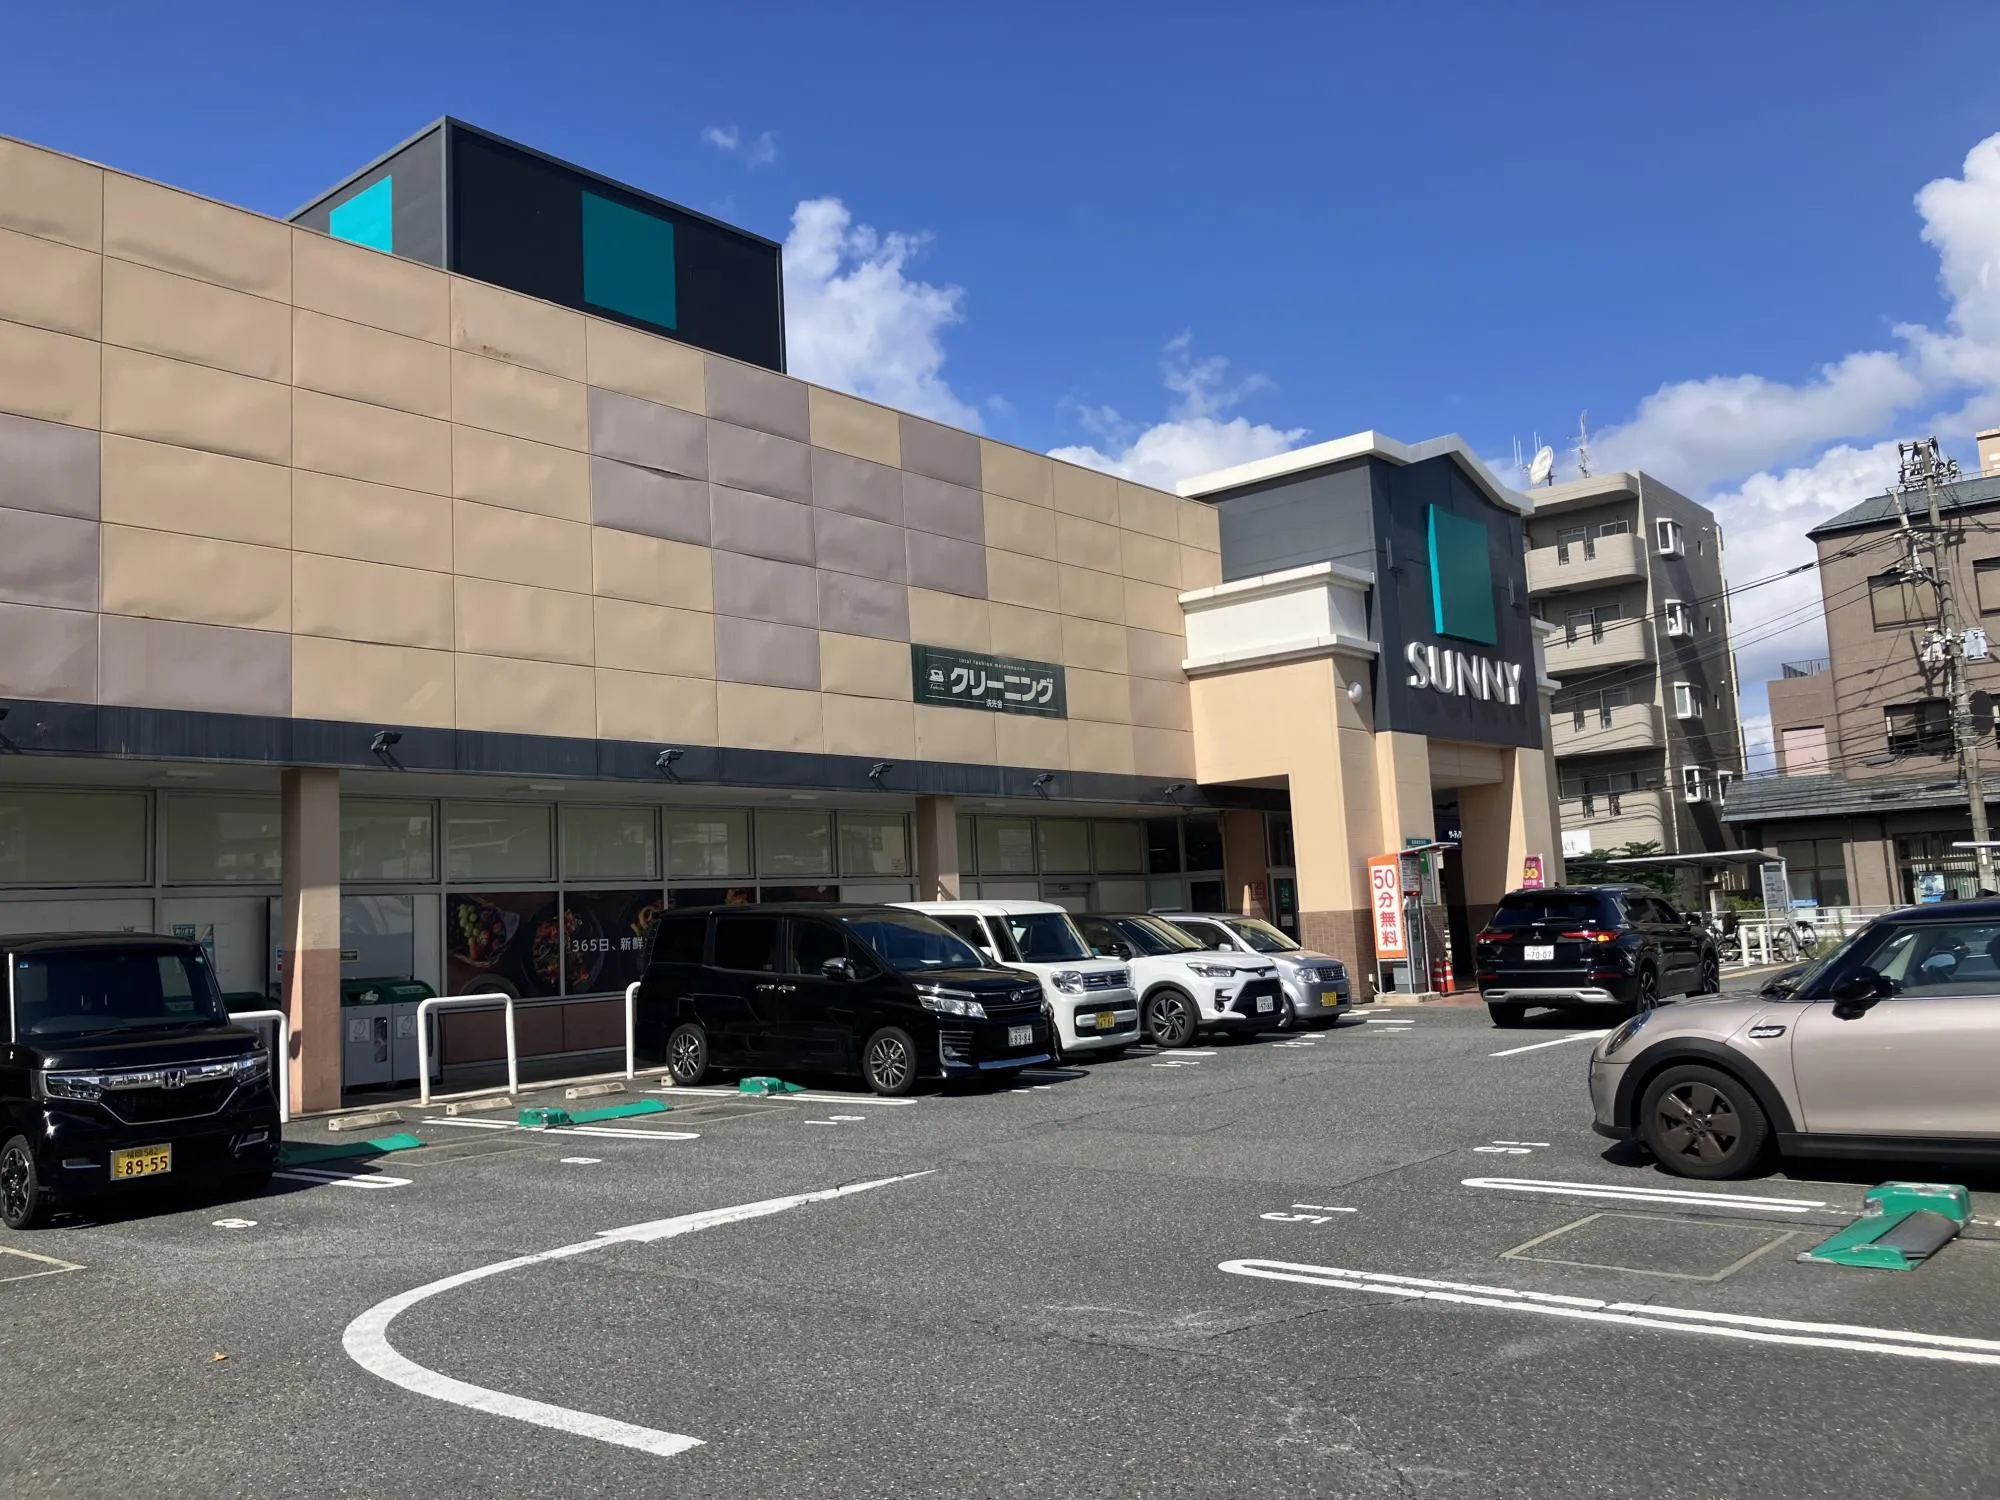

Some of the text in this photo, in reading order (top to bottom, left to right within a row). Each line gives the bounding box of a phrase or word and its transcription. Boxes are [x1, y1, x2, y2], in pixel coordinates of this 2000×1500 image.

[950, 667, 1053, 704] クリーニング
[1404, 641, 1521, 704] SUNNY
[1373, 868, 1397, 947] 50分無料
[571, 936, 649, 953] 365日、新鮮
[125, 1156, 168, 1175] 89-55
[1259, 1203, 1358, 1225] 15
